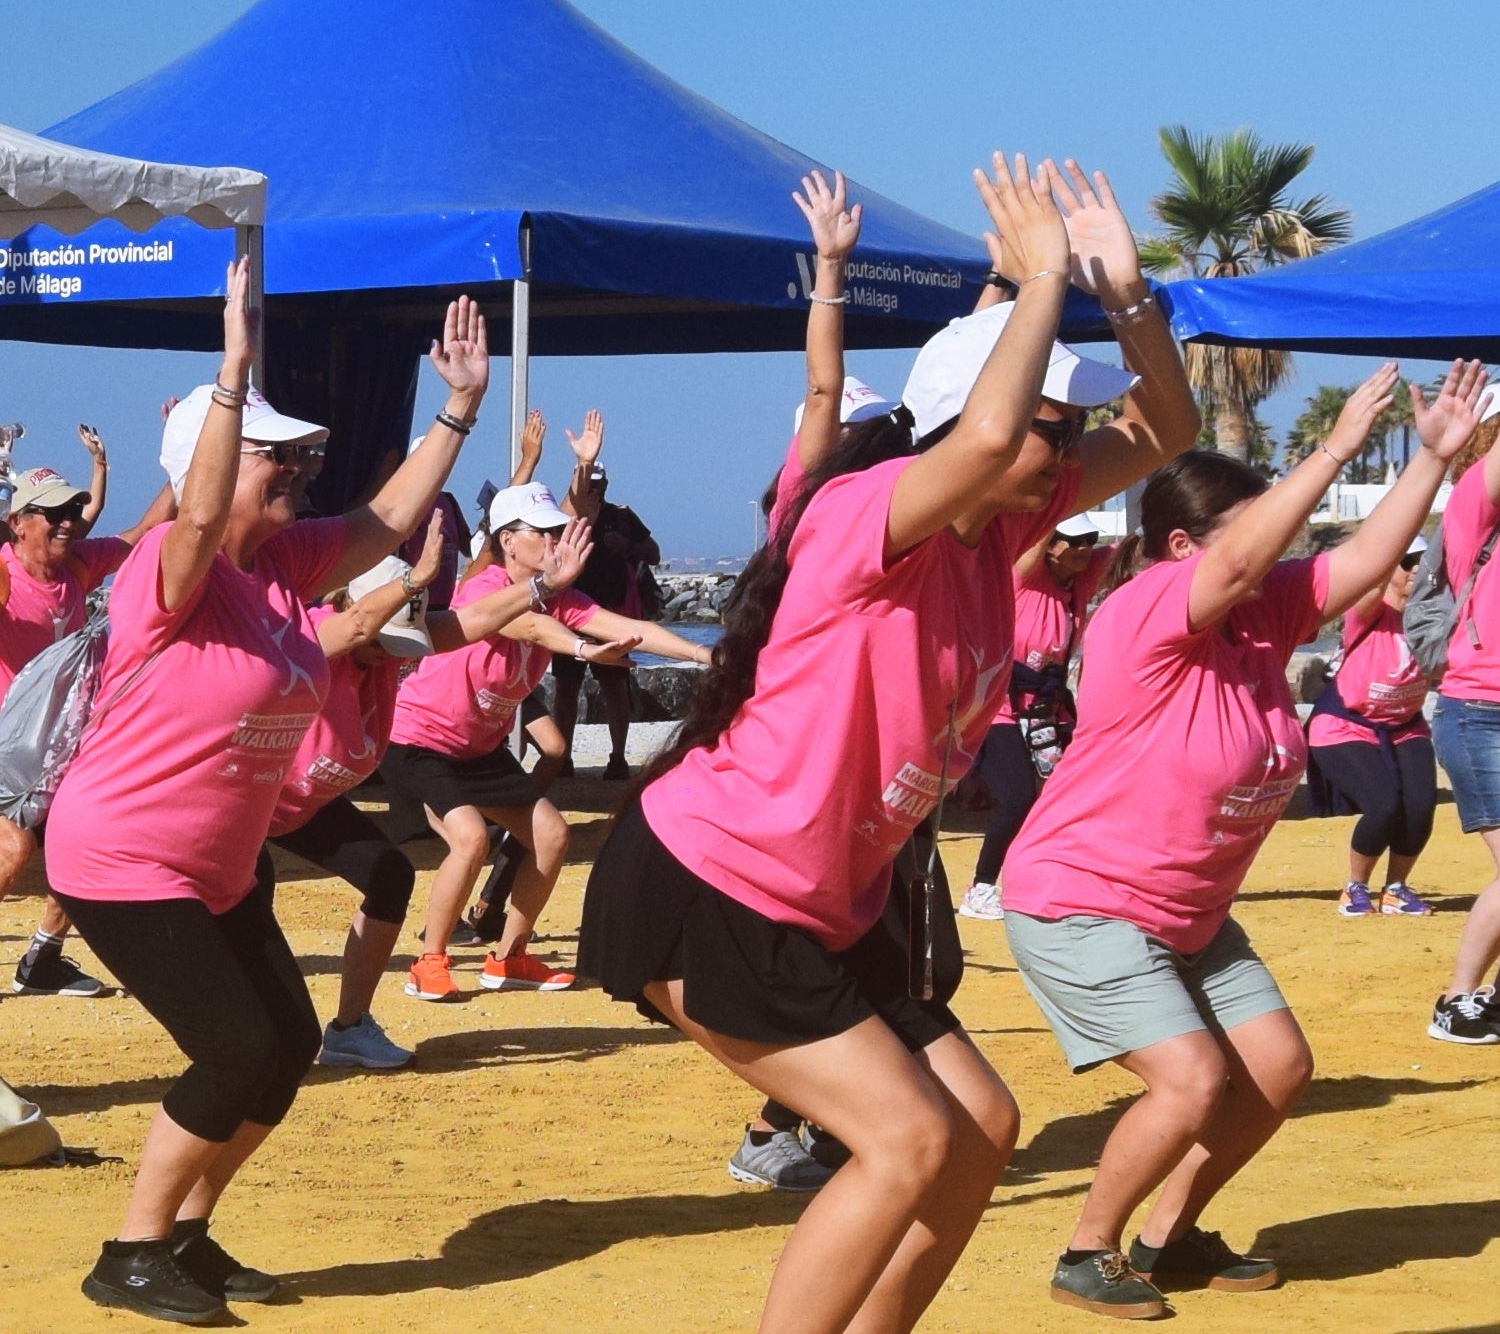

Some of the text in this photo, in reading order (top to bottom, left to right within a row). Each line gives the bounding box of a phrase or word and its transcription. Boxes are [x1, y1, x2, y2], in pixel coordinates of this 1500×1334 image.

[89, 241, 173, 264] Provincial
[20, 274, 82, 297] Málaga
[843, 261, 962, 289] iputación Provincial
[853, 286, 898, 313] Málaga
